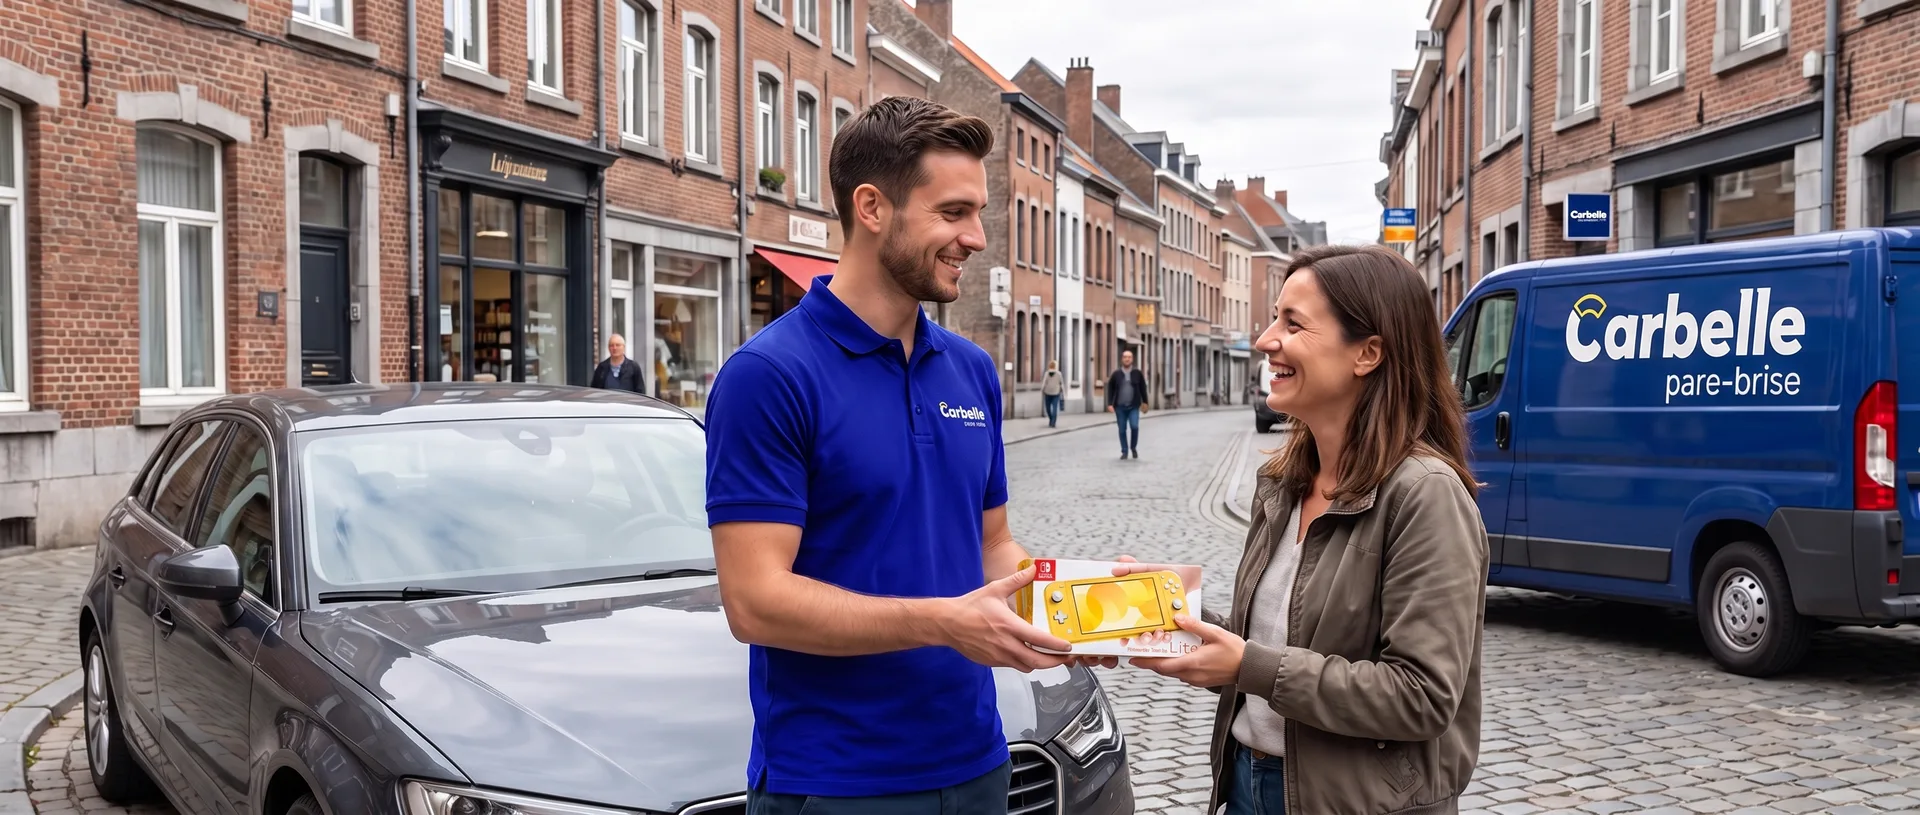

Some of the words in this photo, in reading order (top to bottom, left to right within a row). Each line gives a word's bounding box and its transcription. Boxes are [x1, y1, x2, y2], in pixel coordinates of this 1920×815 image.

[1570, 210, 1607, 219] Carbelle
[1566, 287, 1806, 363] Carbelle
[1665, 364, 1801, 404] pare-brise
[939, 401, 985, 420] Carbelle
[1169, 641, 1198, 654] Lite
